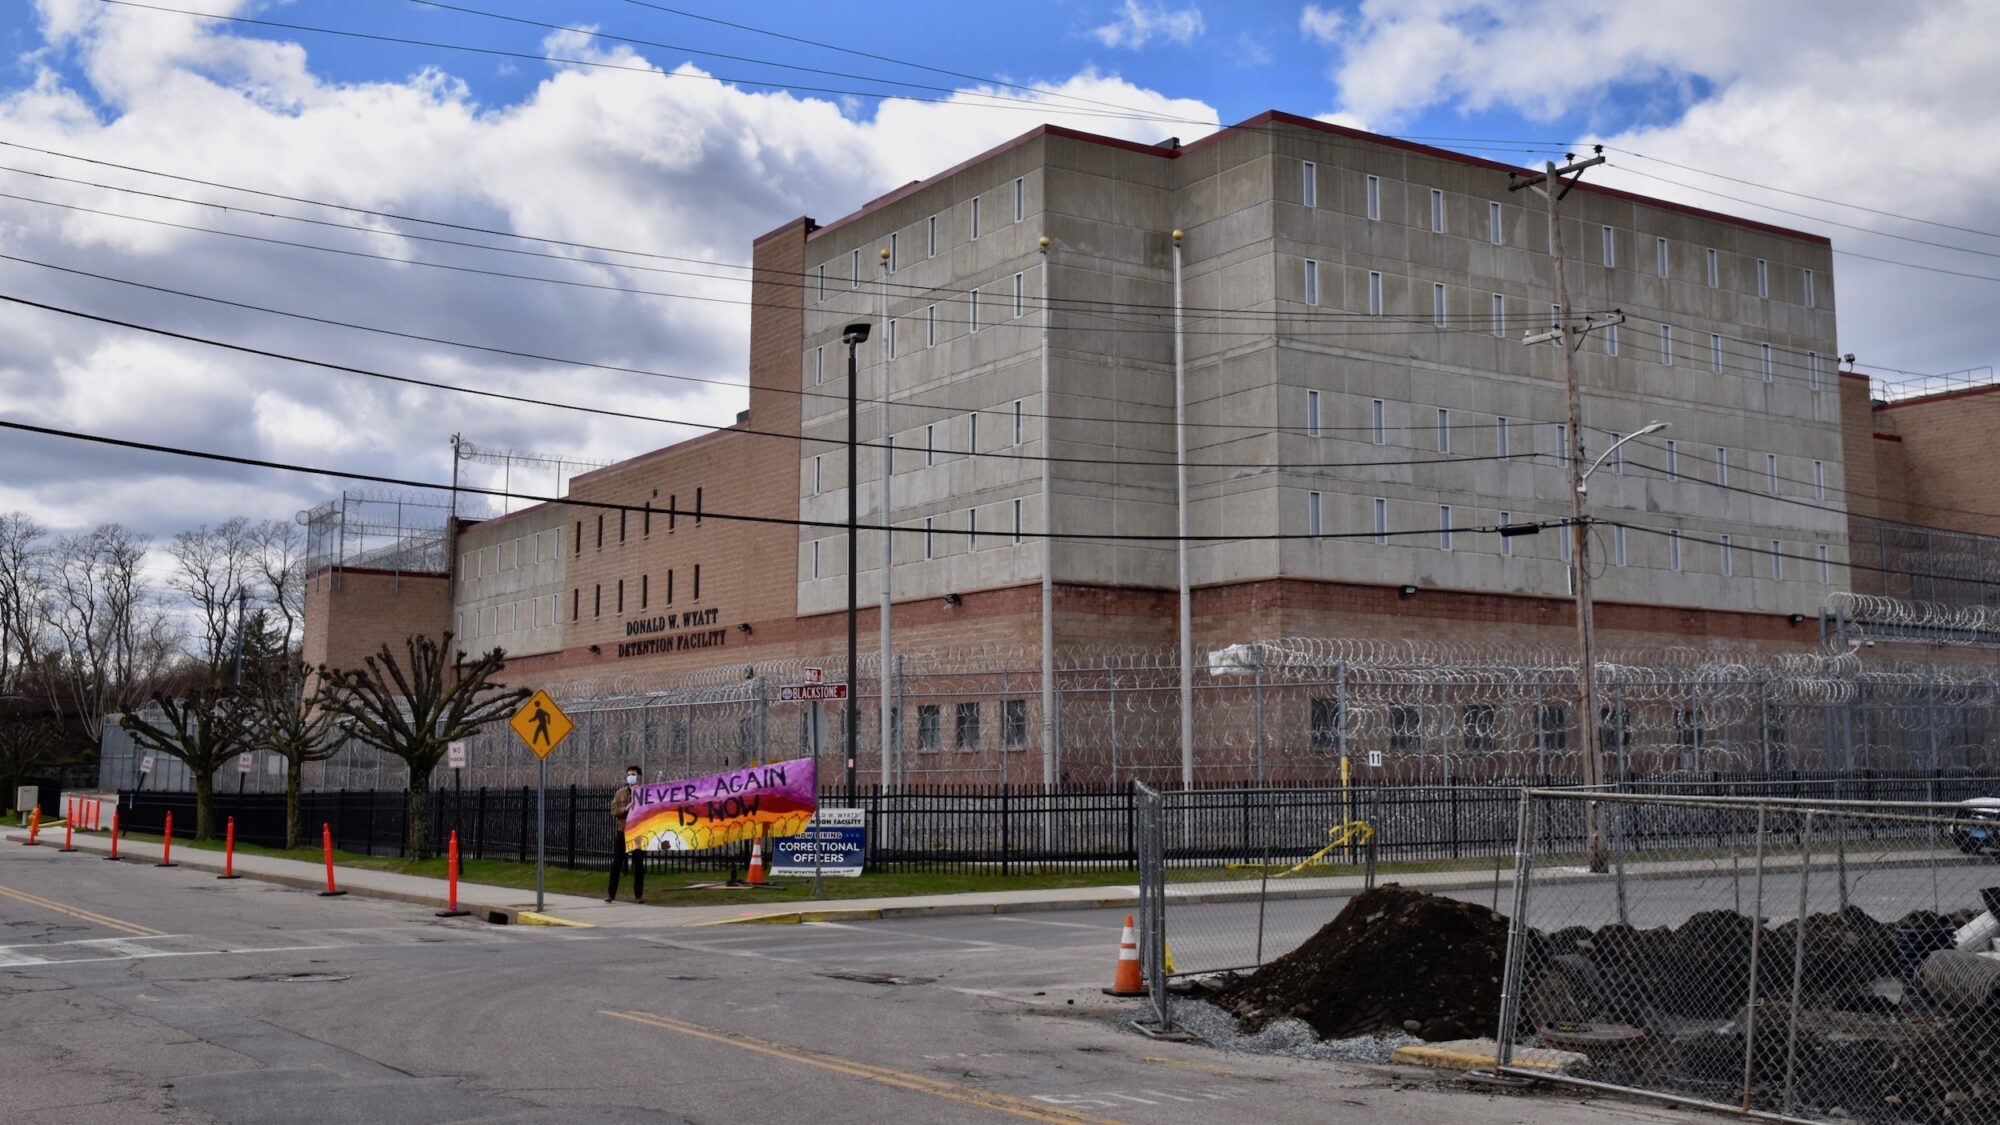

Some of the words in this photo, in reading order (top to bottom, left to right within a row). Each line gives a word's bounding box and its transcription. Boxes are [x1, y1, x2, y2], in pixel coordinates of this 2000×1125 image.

[626, 617, 665, 636] DONALD
[668, 614, 680, 629] W.
[682, 608, 719, 627] WYATT
[618, 636, 674, 658] DETENTION
[677, 629, 727, 651] FACILITY
[793, 686, 838, 699] BLACKSTONE
[1371, 753, 1380, 765] 11
[632, 784, 699, 807] NEVER
[714, 766, 787, 797] AGAIN
[677, 805, 698, 827] IS
[707, 794, 761, 823] NOW
[779, 842, 860, 851] CORRECTIONAL
